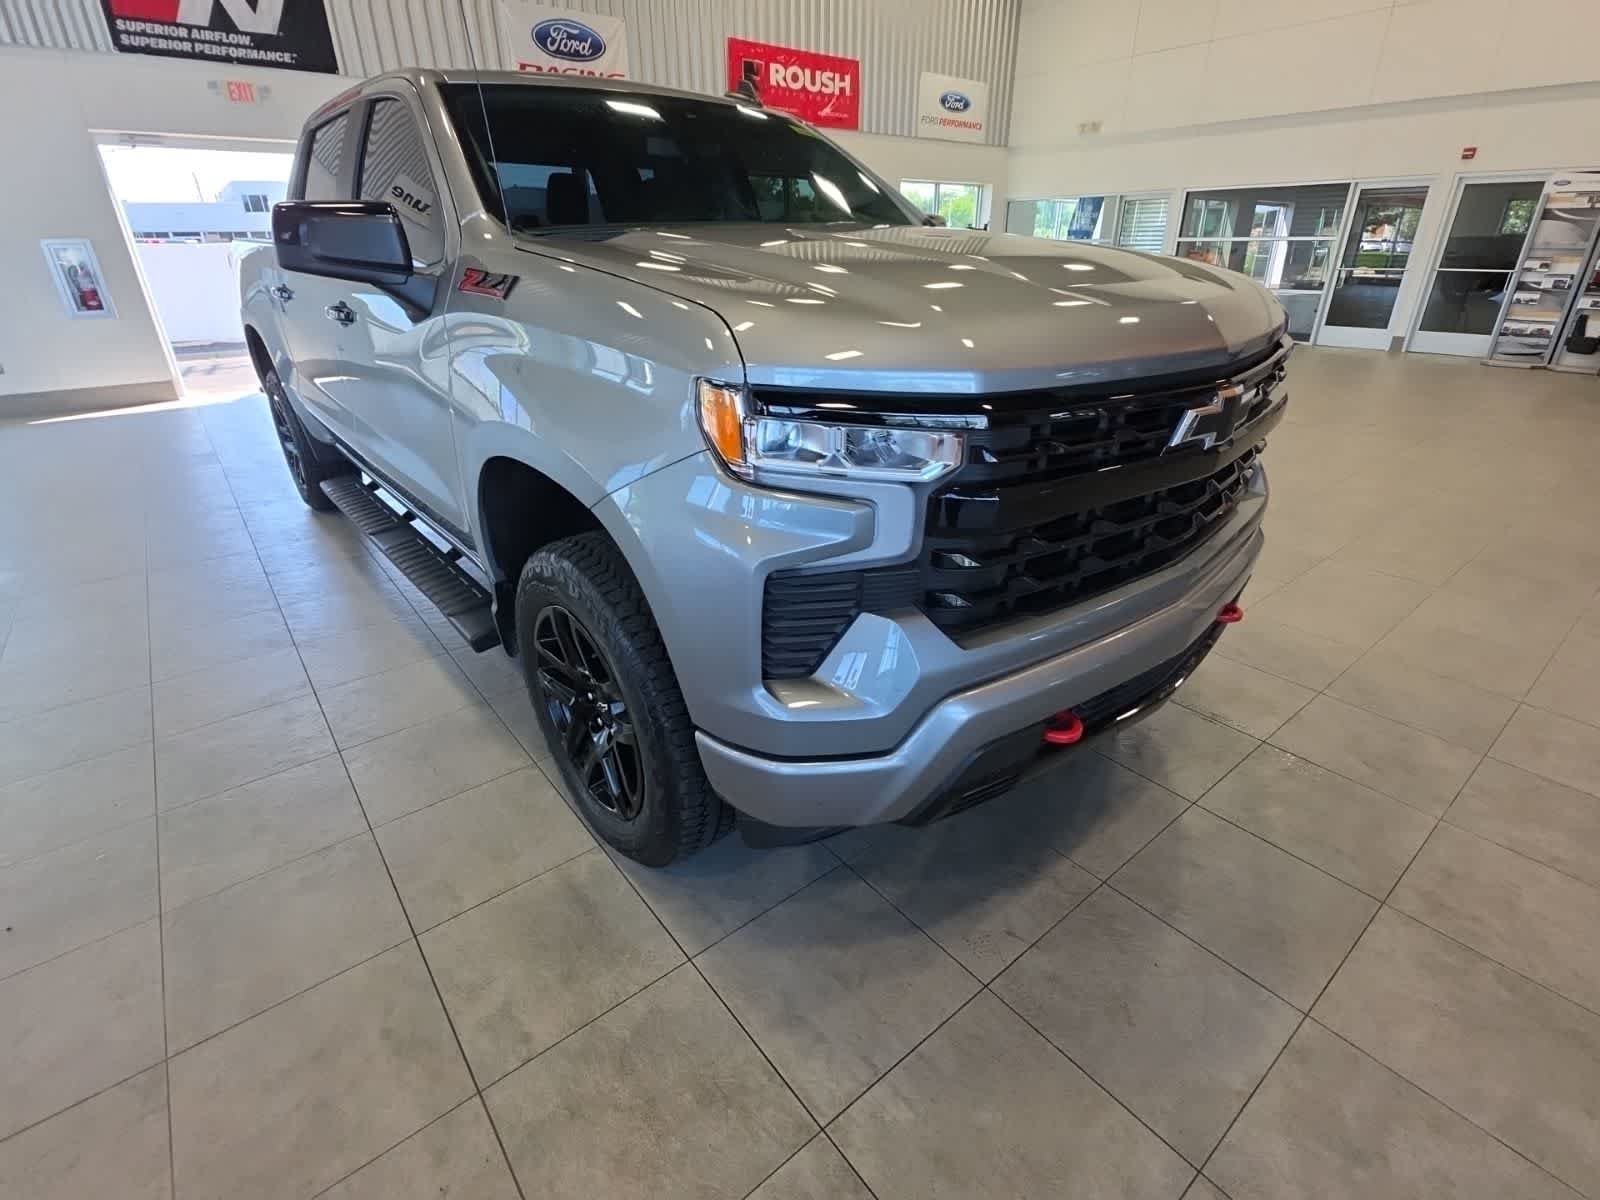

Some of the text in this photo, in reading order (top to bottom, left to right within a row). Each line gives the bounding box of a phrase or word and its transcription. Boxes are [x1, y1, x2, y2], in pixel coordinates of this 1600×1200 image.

[116, 19, 254, 47] SUPERIOR AIRFLOW.
[120, 34, 193, 53] SUPERIOR
[547, 24, 593, 56] Ford
[226, 80, 255, 103] EXIT
[769, 62, 851, 97] ROUSH
